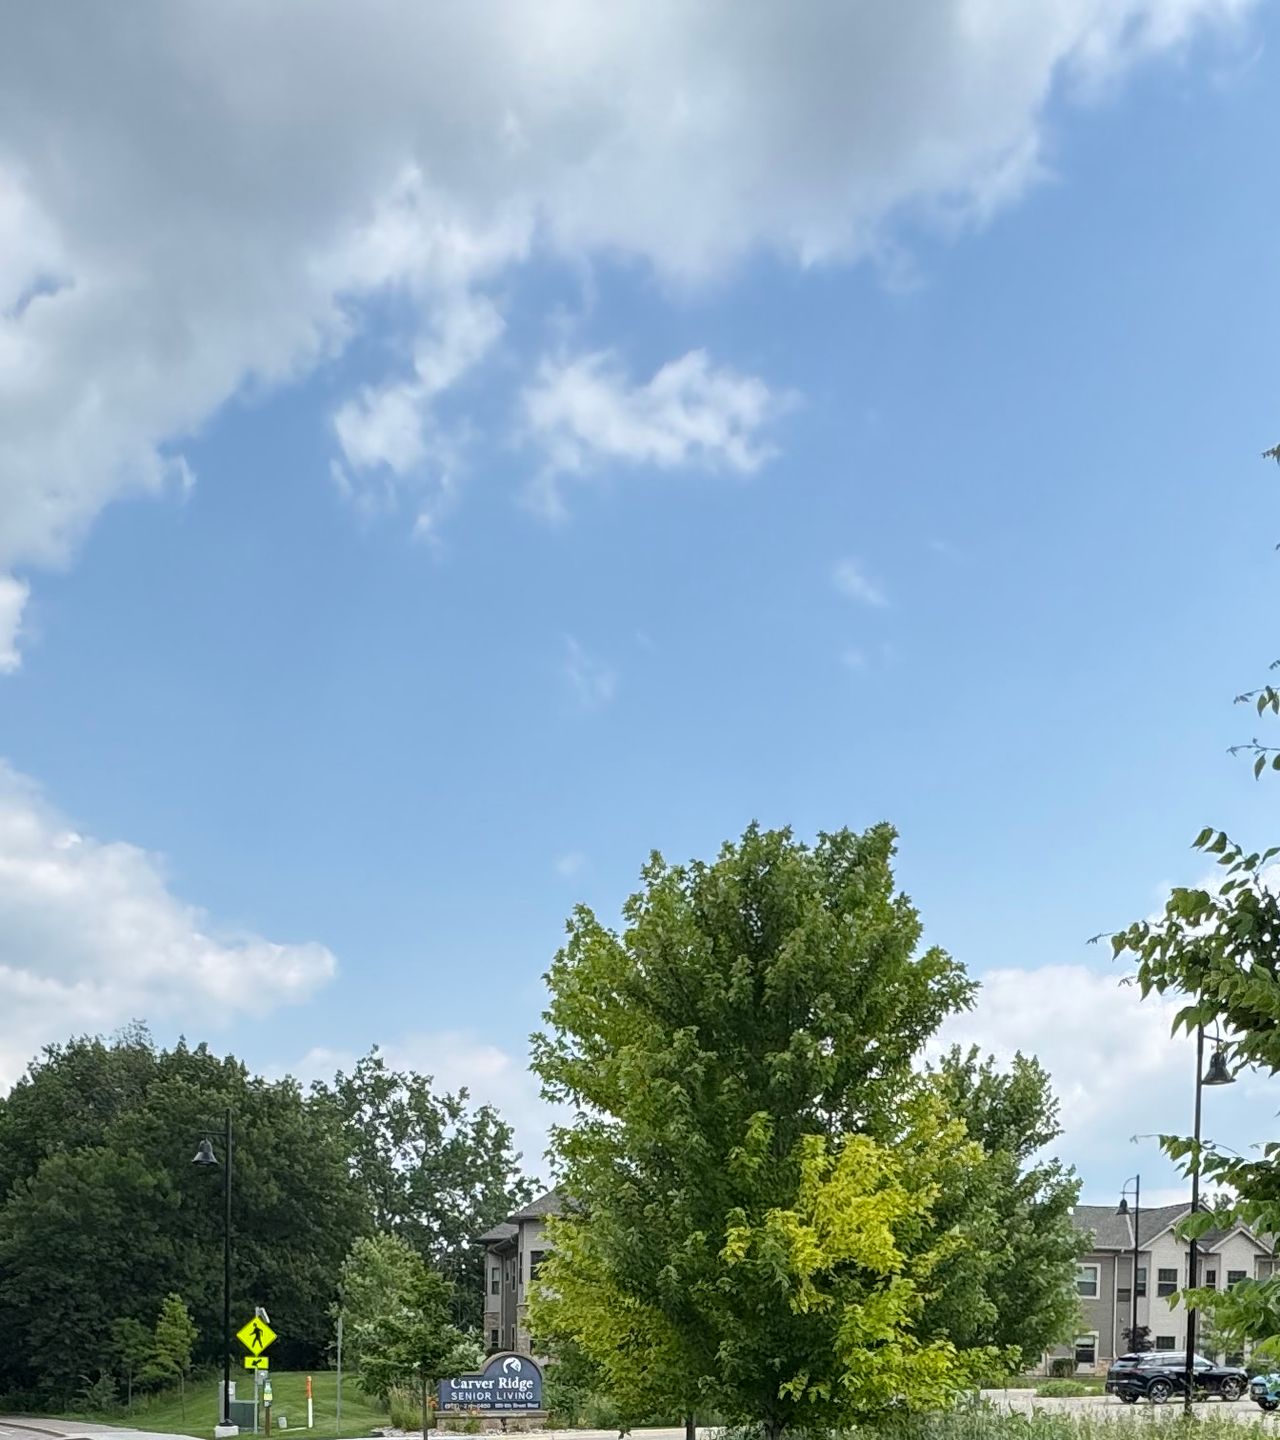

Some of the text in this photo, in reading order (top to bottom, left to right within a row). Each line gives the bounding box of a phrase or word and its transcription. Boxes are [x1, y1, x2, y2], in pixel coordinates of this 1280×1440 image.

[451, 1377, 534, 1392] Carver Ridge
[451, 1391, 534, 1401] SENIOR LIVING
